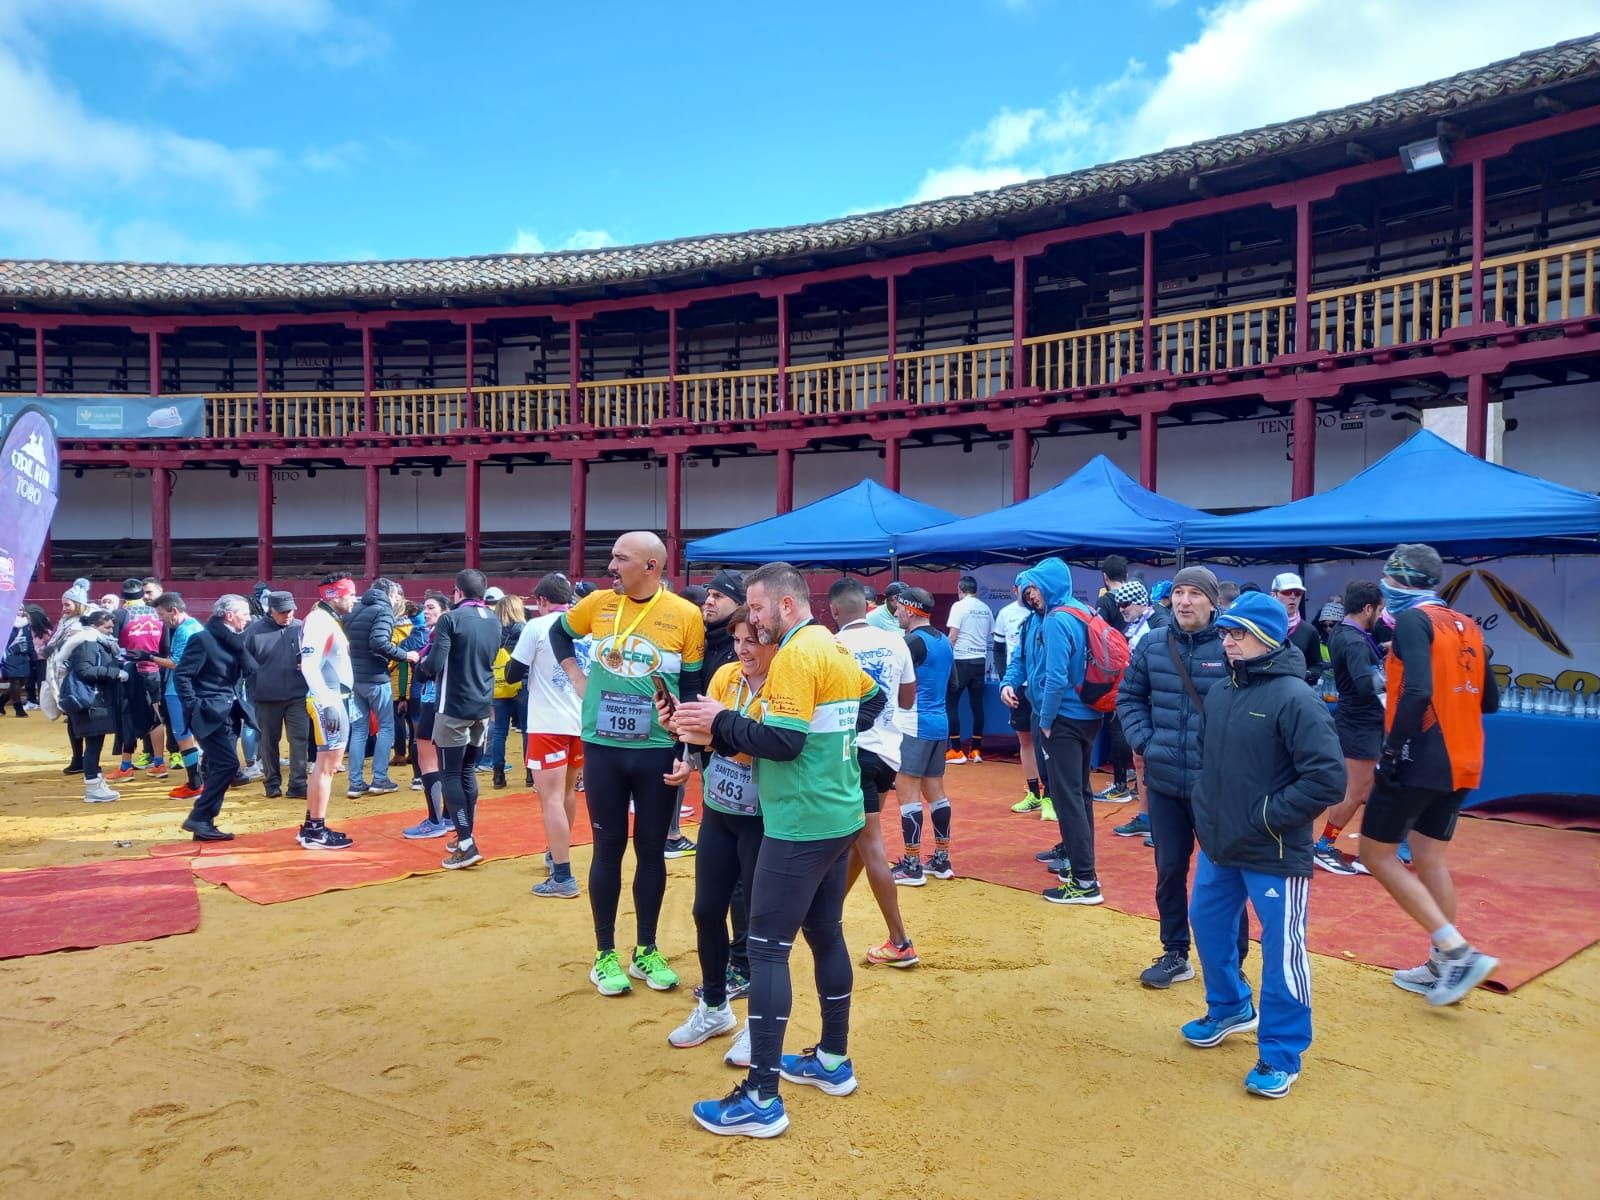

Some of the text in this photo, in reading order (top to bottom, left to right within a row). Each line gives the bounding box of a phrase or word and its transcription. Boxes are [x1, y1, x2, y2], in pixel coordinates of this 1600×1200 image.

[1258, 414, 1337, 434] TENO
[16, 474, 42, 505] TORO
[609, 716, 636, 731] 198
[714, 763, 738, 779] SANTOS
[717, 778, 744, 801] 463
